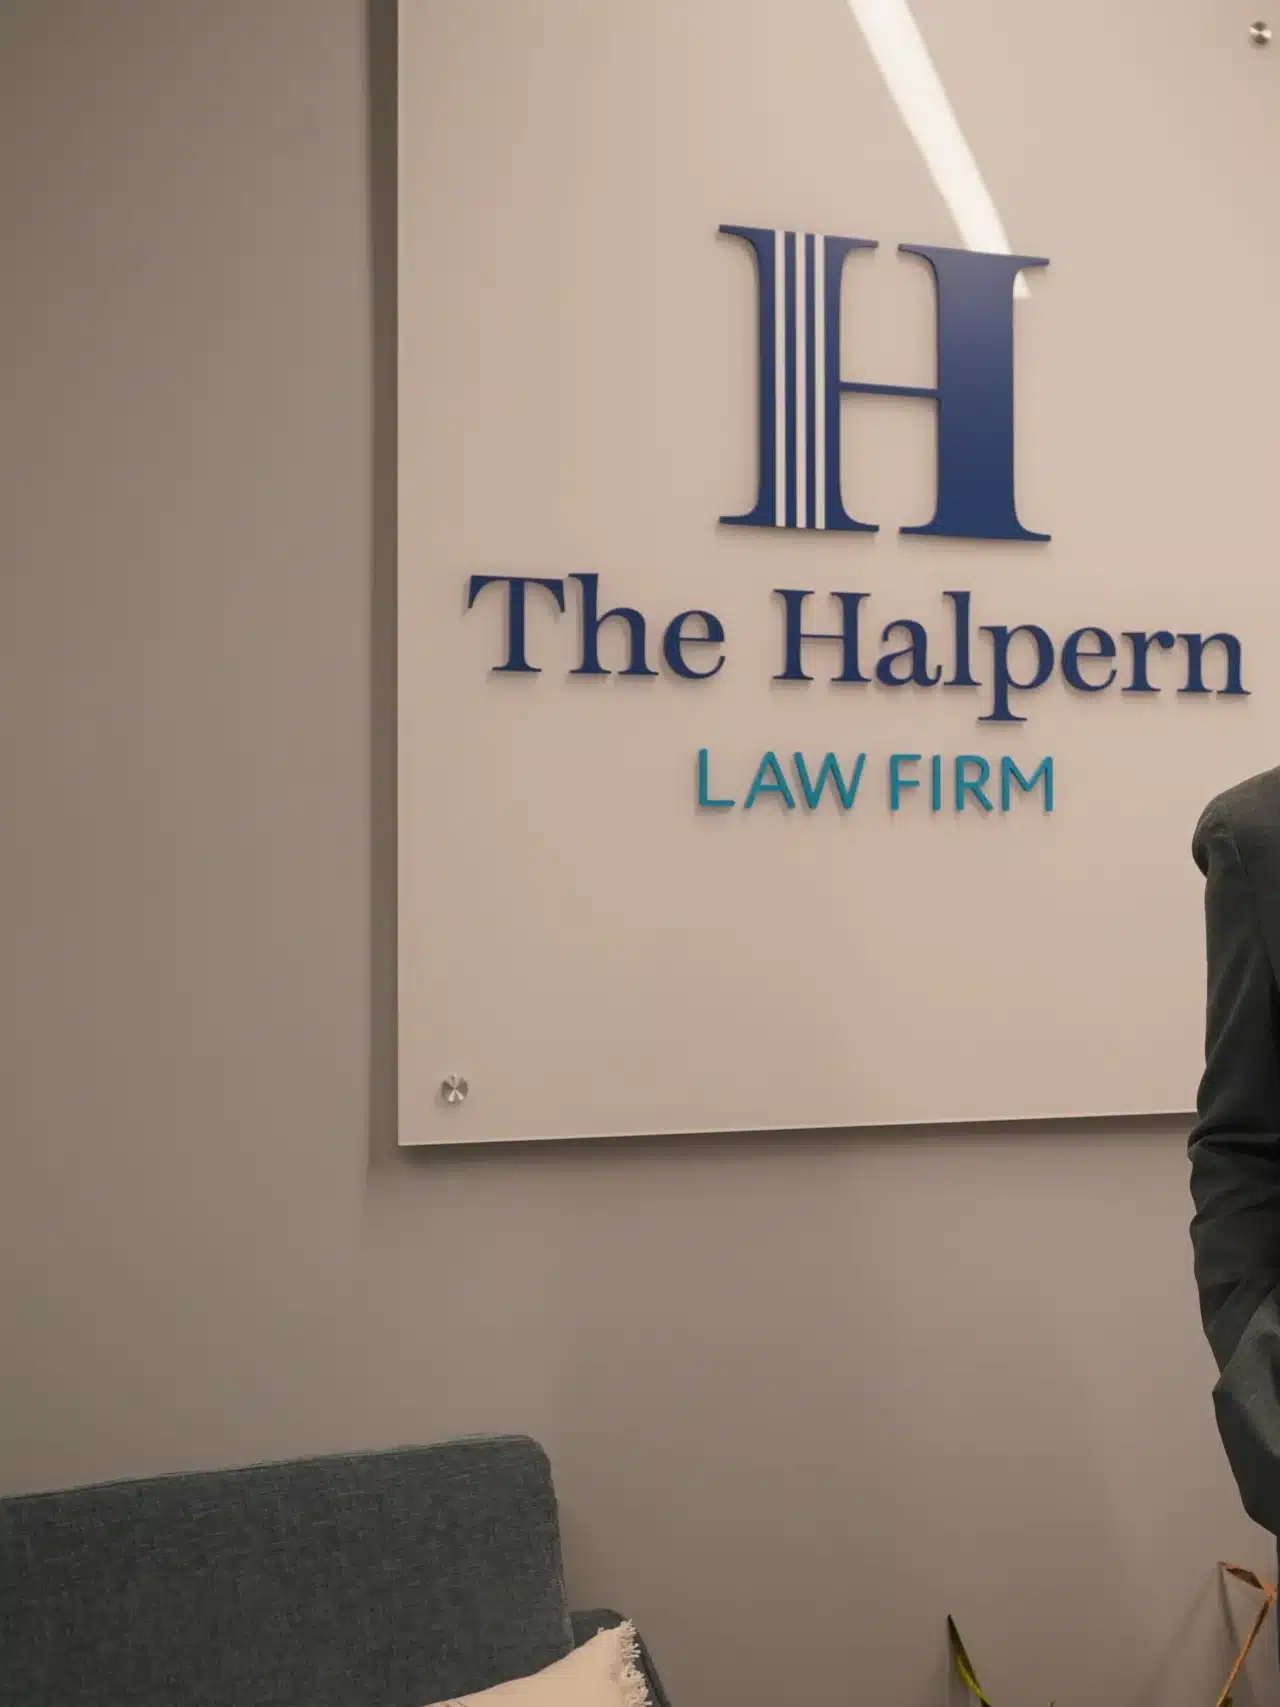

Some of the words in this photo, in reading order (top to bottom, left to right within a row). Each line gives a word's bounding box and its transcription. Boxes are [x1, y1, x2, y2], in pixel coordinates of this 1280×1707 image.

[719, 225, 1051, 542] H
[468, 573, 726, 680] The
[773, 588, 1251, 721] Halpern
[697, 747, 867, 810] LAW
[888, 753, 1055, 813] FIRM
